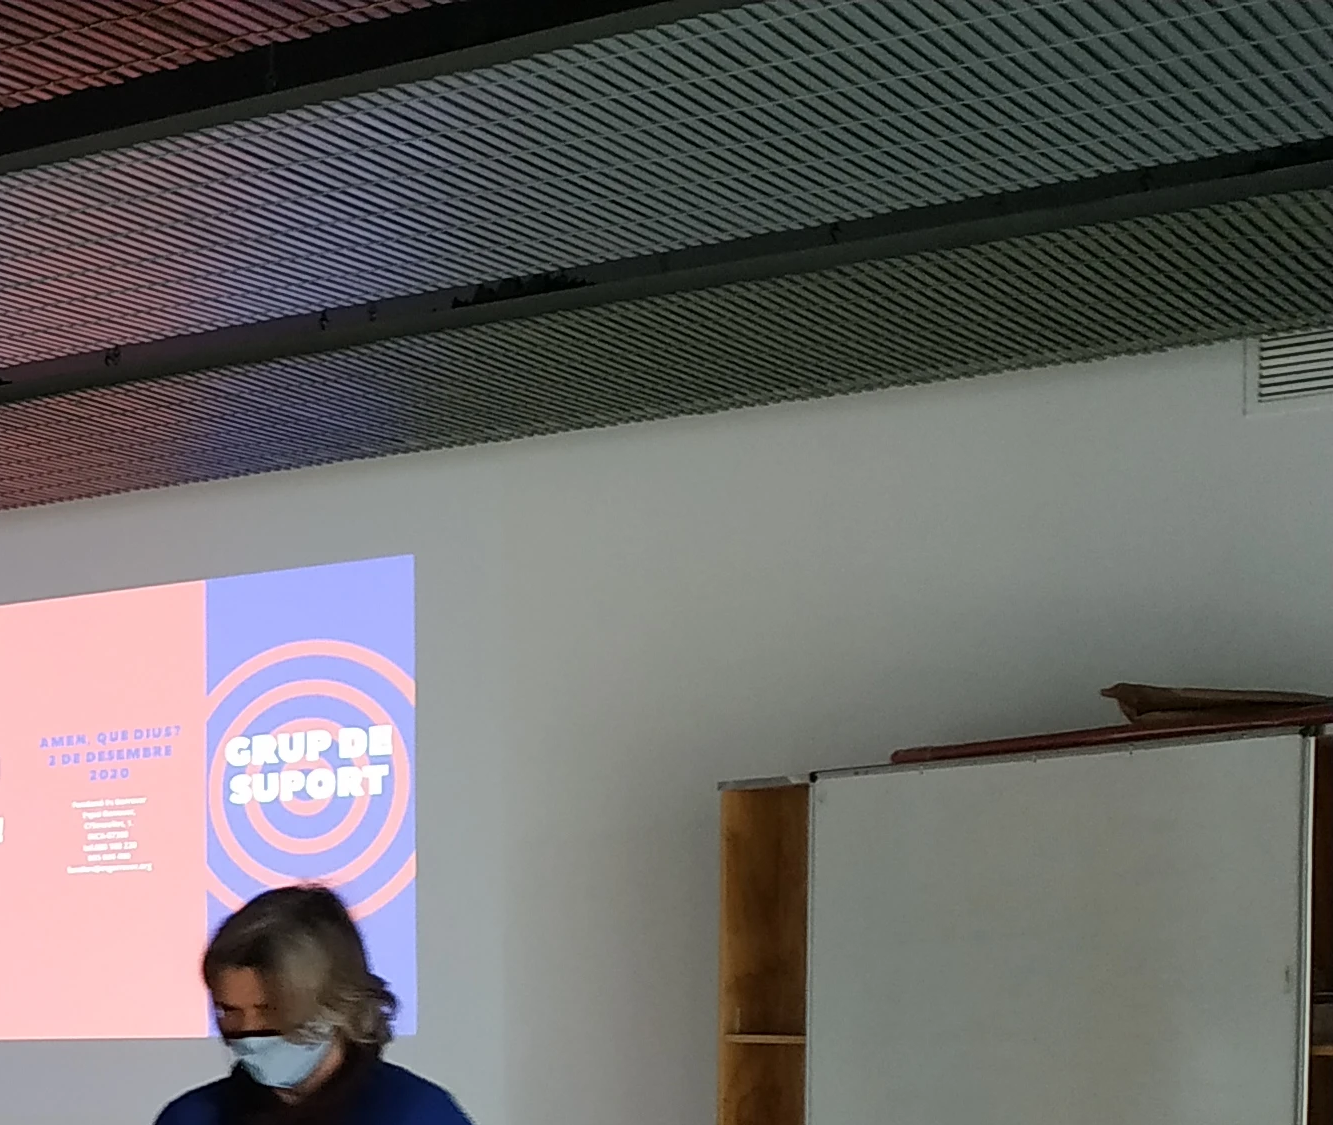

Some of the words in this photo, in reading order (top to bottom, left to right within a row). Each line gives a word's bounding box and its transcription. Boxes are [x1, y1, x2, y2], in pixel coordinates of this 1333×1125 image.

[96, 730, 129, 746] QUE
[133, 725, 181, 740] DIUS?
[224, 729, 332, 767] GRUP
[337, 724, 393, 759] DE
[48, 755, 56, 766] 2
[61, 753, 80, 765] DE
[85, 744, 172, 763] DESEMBRE
[89, 767, 129, 781] 2020
[229, 764, 389, 805] SUPORT
